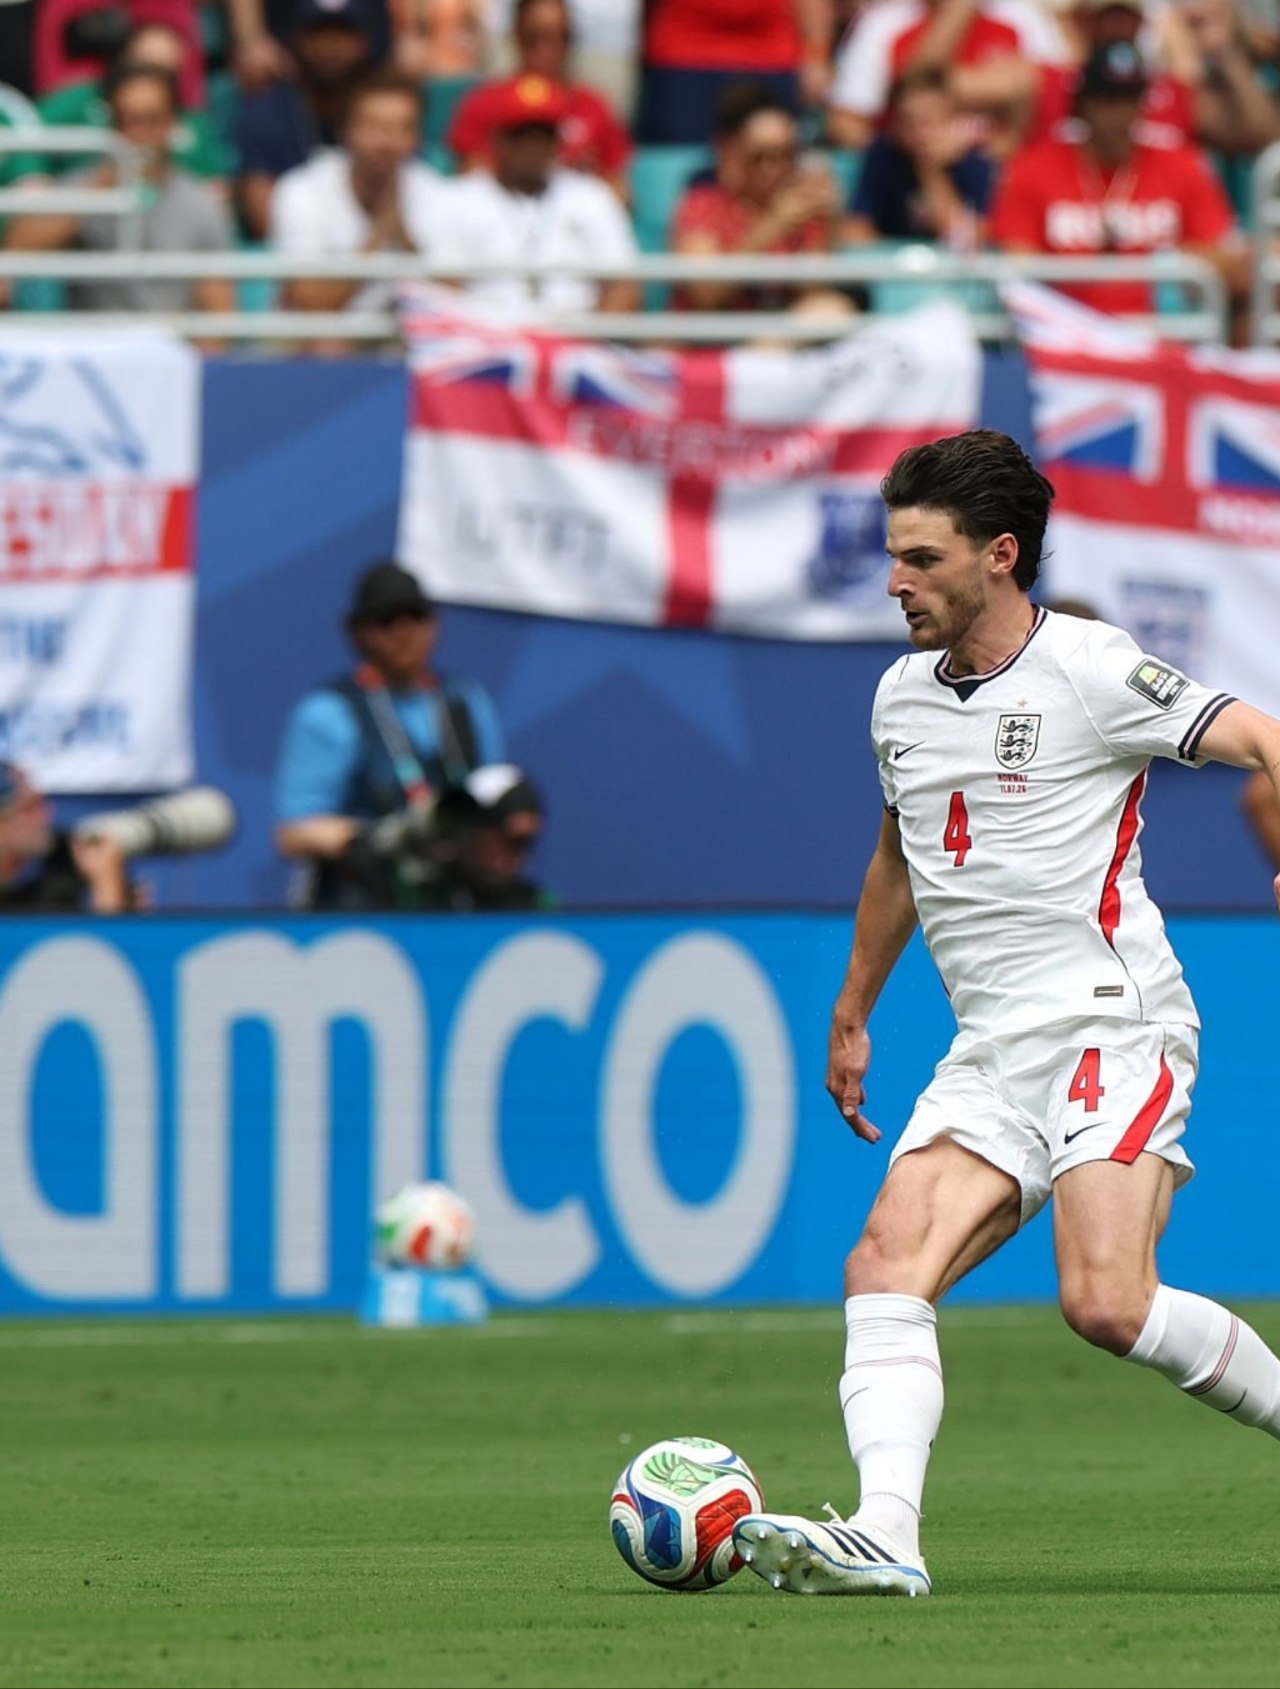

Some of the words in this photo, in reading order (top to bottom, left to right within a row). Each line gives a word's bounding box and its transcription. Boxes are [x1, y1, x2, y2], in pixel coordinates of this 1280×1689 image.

[997, 773, 1028, 782] NORWAY
[943, 791, 972, 867] 4
[1068, 1048, 1104, 1112] 4
